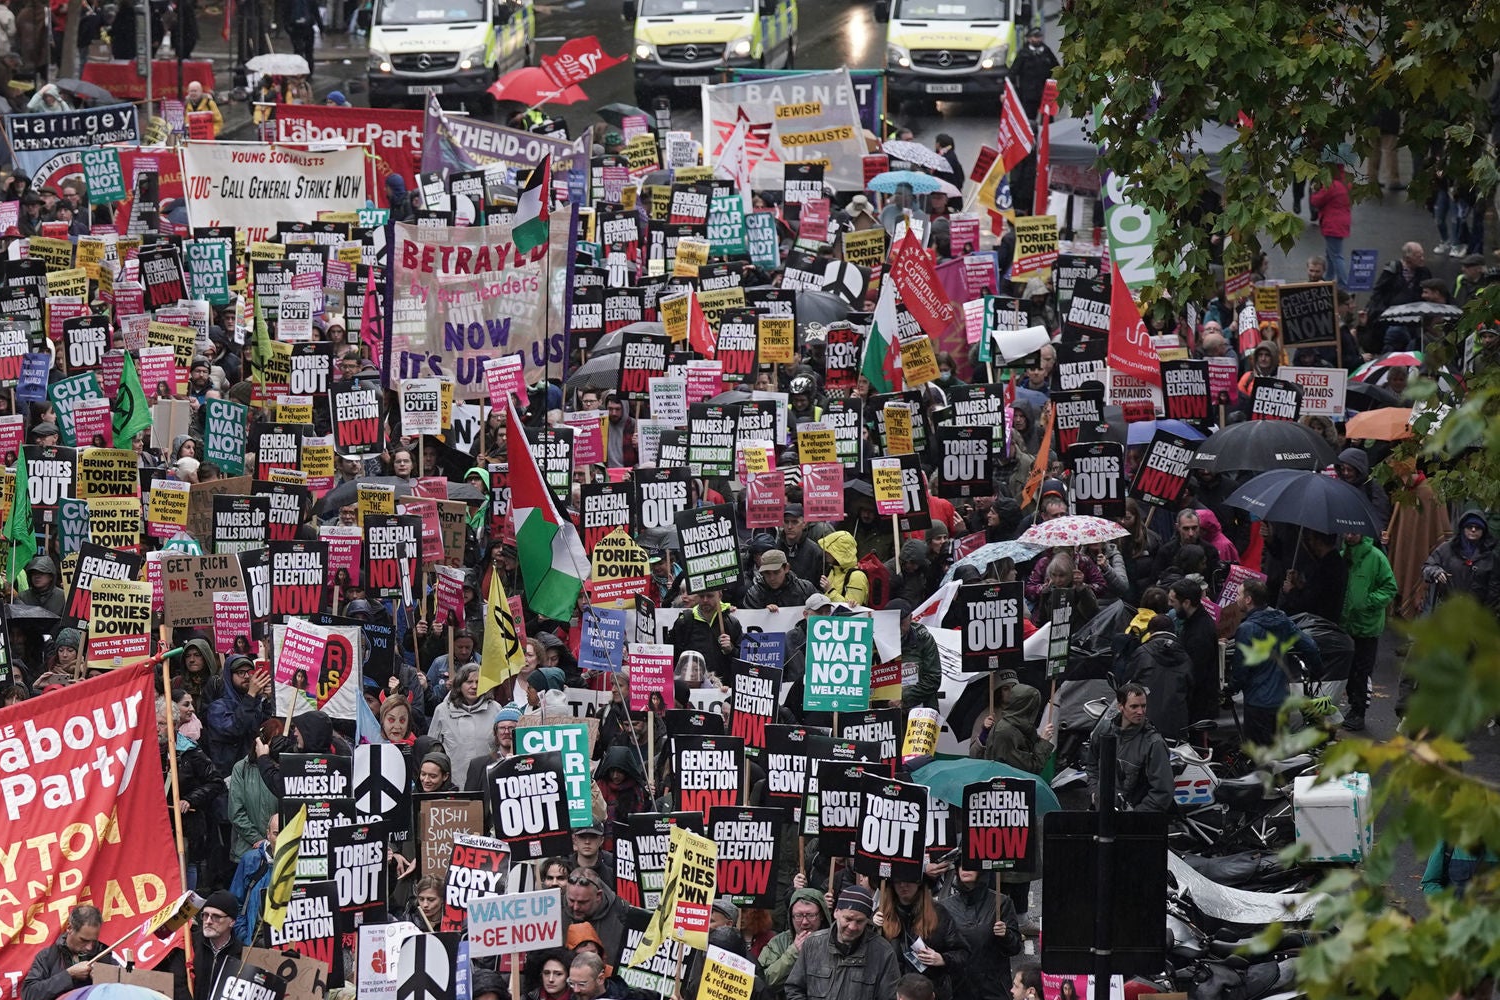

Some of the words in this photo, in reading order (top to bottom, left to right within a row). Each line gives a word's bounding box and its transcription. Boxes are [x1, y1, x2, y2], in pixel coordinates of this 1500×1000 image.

[746, 84, 871, 105] BARNET
[777, 104, 820, 117] JEWISH
[13, 110, 131, 134] Haringey
[280, 120, 364, 143] Labour
[14, 138, 50, 149] DEFEND
[52, 137, 89, 147] COUNCIL
[92, 129, 135, 144] HOUSING
[85, 151, 114, 165] CUT
[232, 151, 265, 164] YOUNG
[270, 152, 324, 166] SOCIALISTS
[87, 162, 119, 176] WAR
[89, 174, 120, 189] NOT
[91, 187, 122, 195] WELFARE
[249, 176, 292, 199] GENERAL
[295, 175, 331, 198] STRIKE
[335, 175, 361, 198] NOW
[410, 278, 429, 303] by
[904, 260, 953, 320] Community
[905, 277, 939, 319] membership
[445, 318, 511, 351] NOW
[1288, 316, 1335, 341] NOW
[532, 334, 564, 367] US
[1297, 374, 1327, 385] STOKE
[404, 392, 438, 400] TORIES
[406, 399, 437, 411] OUT!
[167, 558, 192, 573] GET
[201, 557, 228, 570] RICH
[169, 579, 188, 592] DIE
[196, 576, 237, 589] TRYING
[321, 616, 333, 624] BIG
[285, 639, 298, 649] out
[298, 642, 315, 654] now!
[287, 630, 324, 649] Braverman
[374, 637, 387, 649] YOU
[281, 656, 310, 672] welcome
[283, 648, 315, 664] Refugees
[278, 665, 294, 674] here
[0, 739, 143, 821] Party
[430, 807, 467, 827] RISHI
[426, 842, 452, 856] HAS
[479, 839, 502, 850] Worker
[452, 846, 505, 871] DEFY
[449, 865, 502, 892] TORY
[469, 898, 524, 923] WAKE
[530, 896, 557, 917] UP
[511, 924, 557, 944] NOW
[711, 963, 747, 985] Migrants
[705, 973, 711, 982] &
[713, 977, 748, 998] refugees
